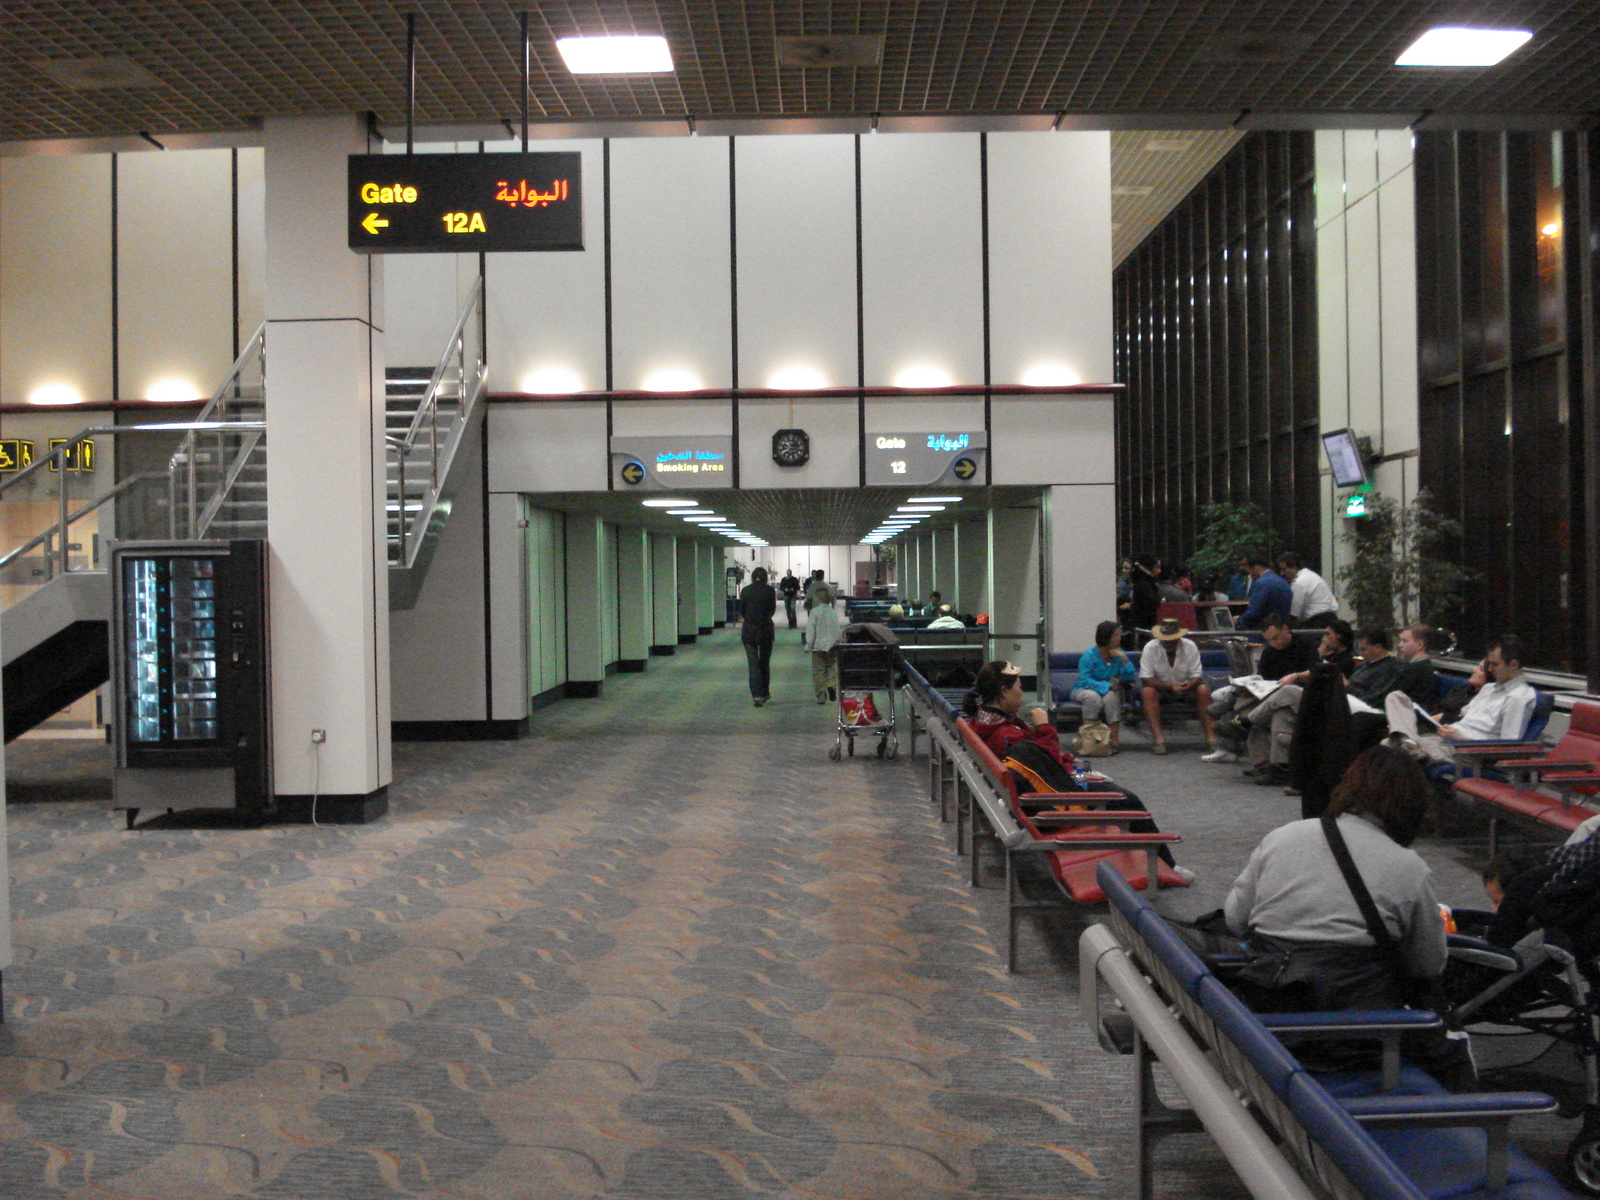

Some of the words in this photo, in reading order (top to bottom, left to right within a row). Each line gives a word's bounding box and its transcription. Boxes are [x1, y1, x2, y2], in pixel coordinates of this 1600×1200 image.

[361, 183, 418, 204] Gate
[496, 179, 568, 208] البوابة
[442, 212, 486, 233] 12A
[876, 436, 906, 449] Gate
[927, 434, 969, 451] البوابة
[656, 462, 699, 473] Smoking
[701, 462, 724, 472] Area
[891, 461, 906, 474] 12
